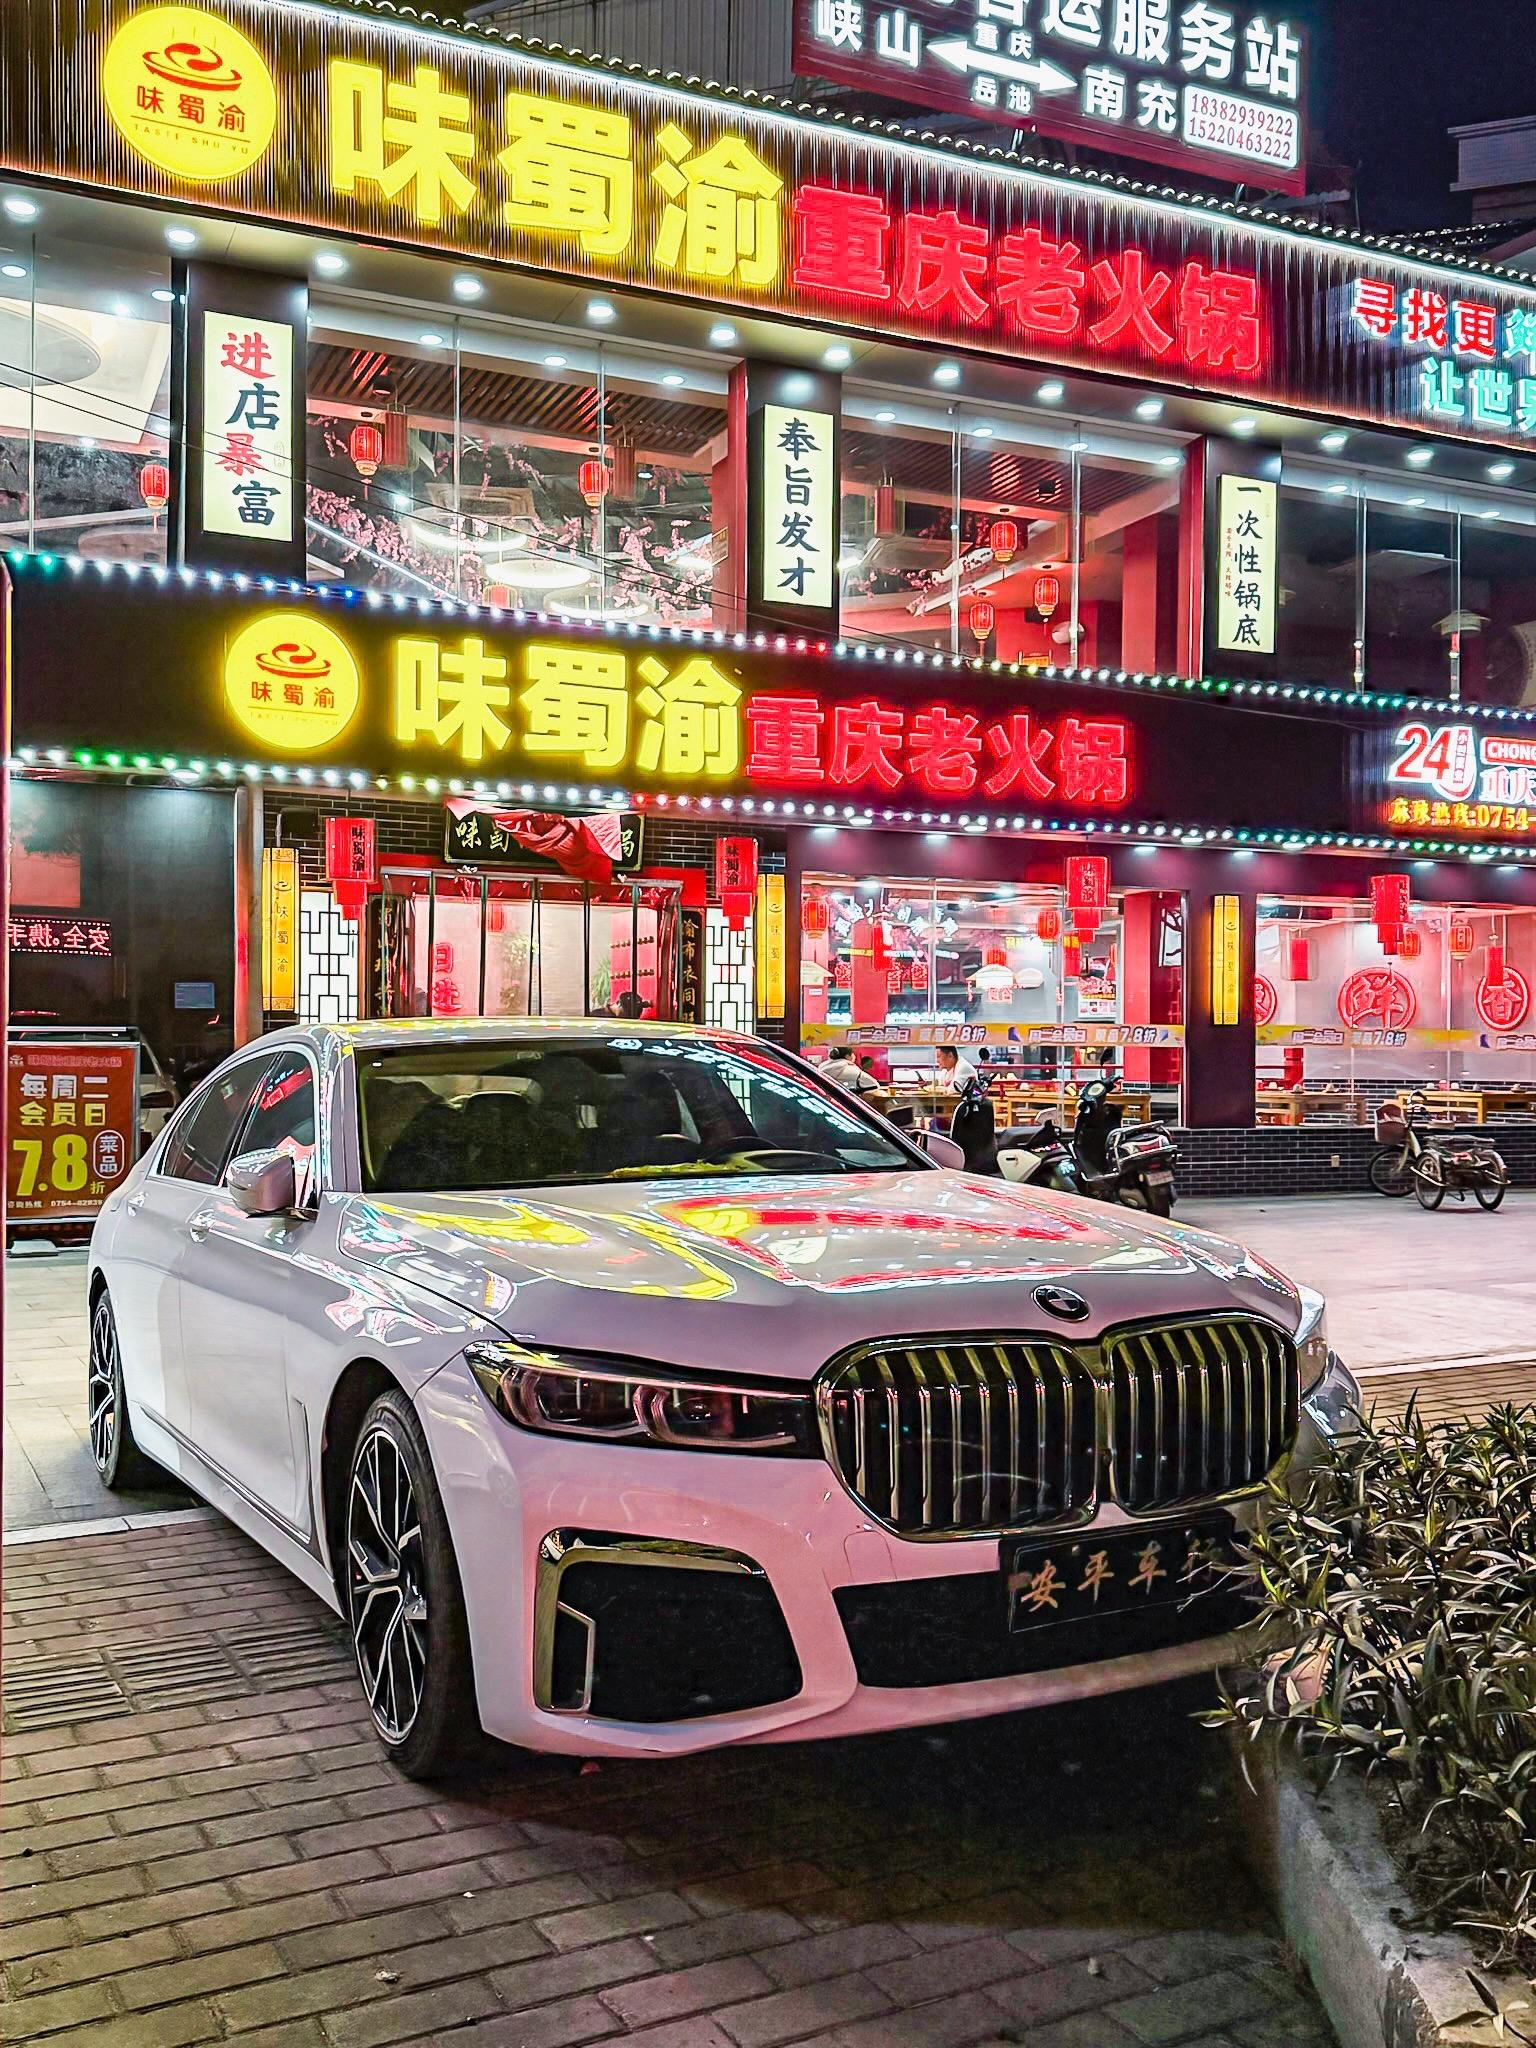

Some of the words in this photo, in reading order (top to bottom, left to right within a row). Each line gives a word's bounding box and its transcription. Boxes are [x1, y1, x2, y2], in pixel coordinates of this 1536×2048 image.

[974, 22, 1032, 60] 重庆
[816, 0, 920, 69] 峡山
[1083, 66, 1178, 132] 南充
[136, 85, 246, 133] 味蜀渝
[974, 75, 1032, 115] 岳池
[1191, 93, 1293, 137] 18382939222
[133, 123, 181, 141] TASTE
[191, 137, 221, 149] SHU
[1189, 117, 1291, 160] 15220463222
[330, 59, 785, 286] 味蜀渝
[793, 184, 1260, 370] 重庆老火锅
[215, 332, 281, 526] 进店暴富
[776, 417, 823, 597] 奉旨发才
[1232, 486, 1263, 647] 一次性锅底
[251, 681, 335, 709] 味蜀渝
[397, 638, 743, 775] 味蜀渝
[746, 696, 1127, 802] 重庆老火锅
[1395, 728, 1451, 780] 24
[20, 1072, 109, 1099] 每周二
[19, 1101, 106, 1127] 会员日
[100, 1135, 119, 1173] 菜品
